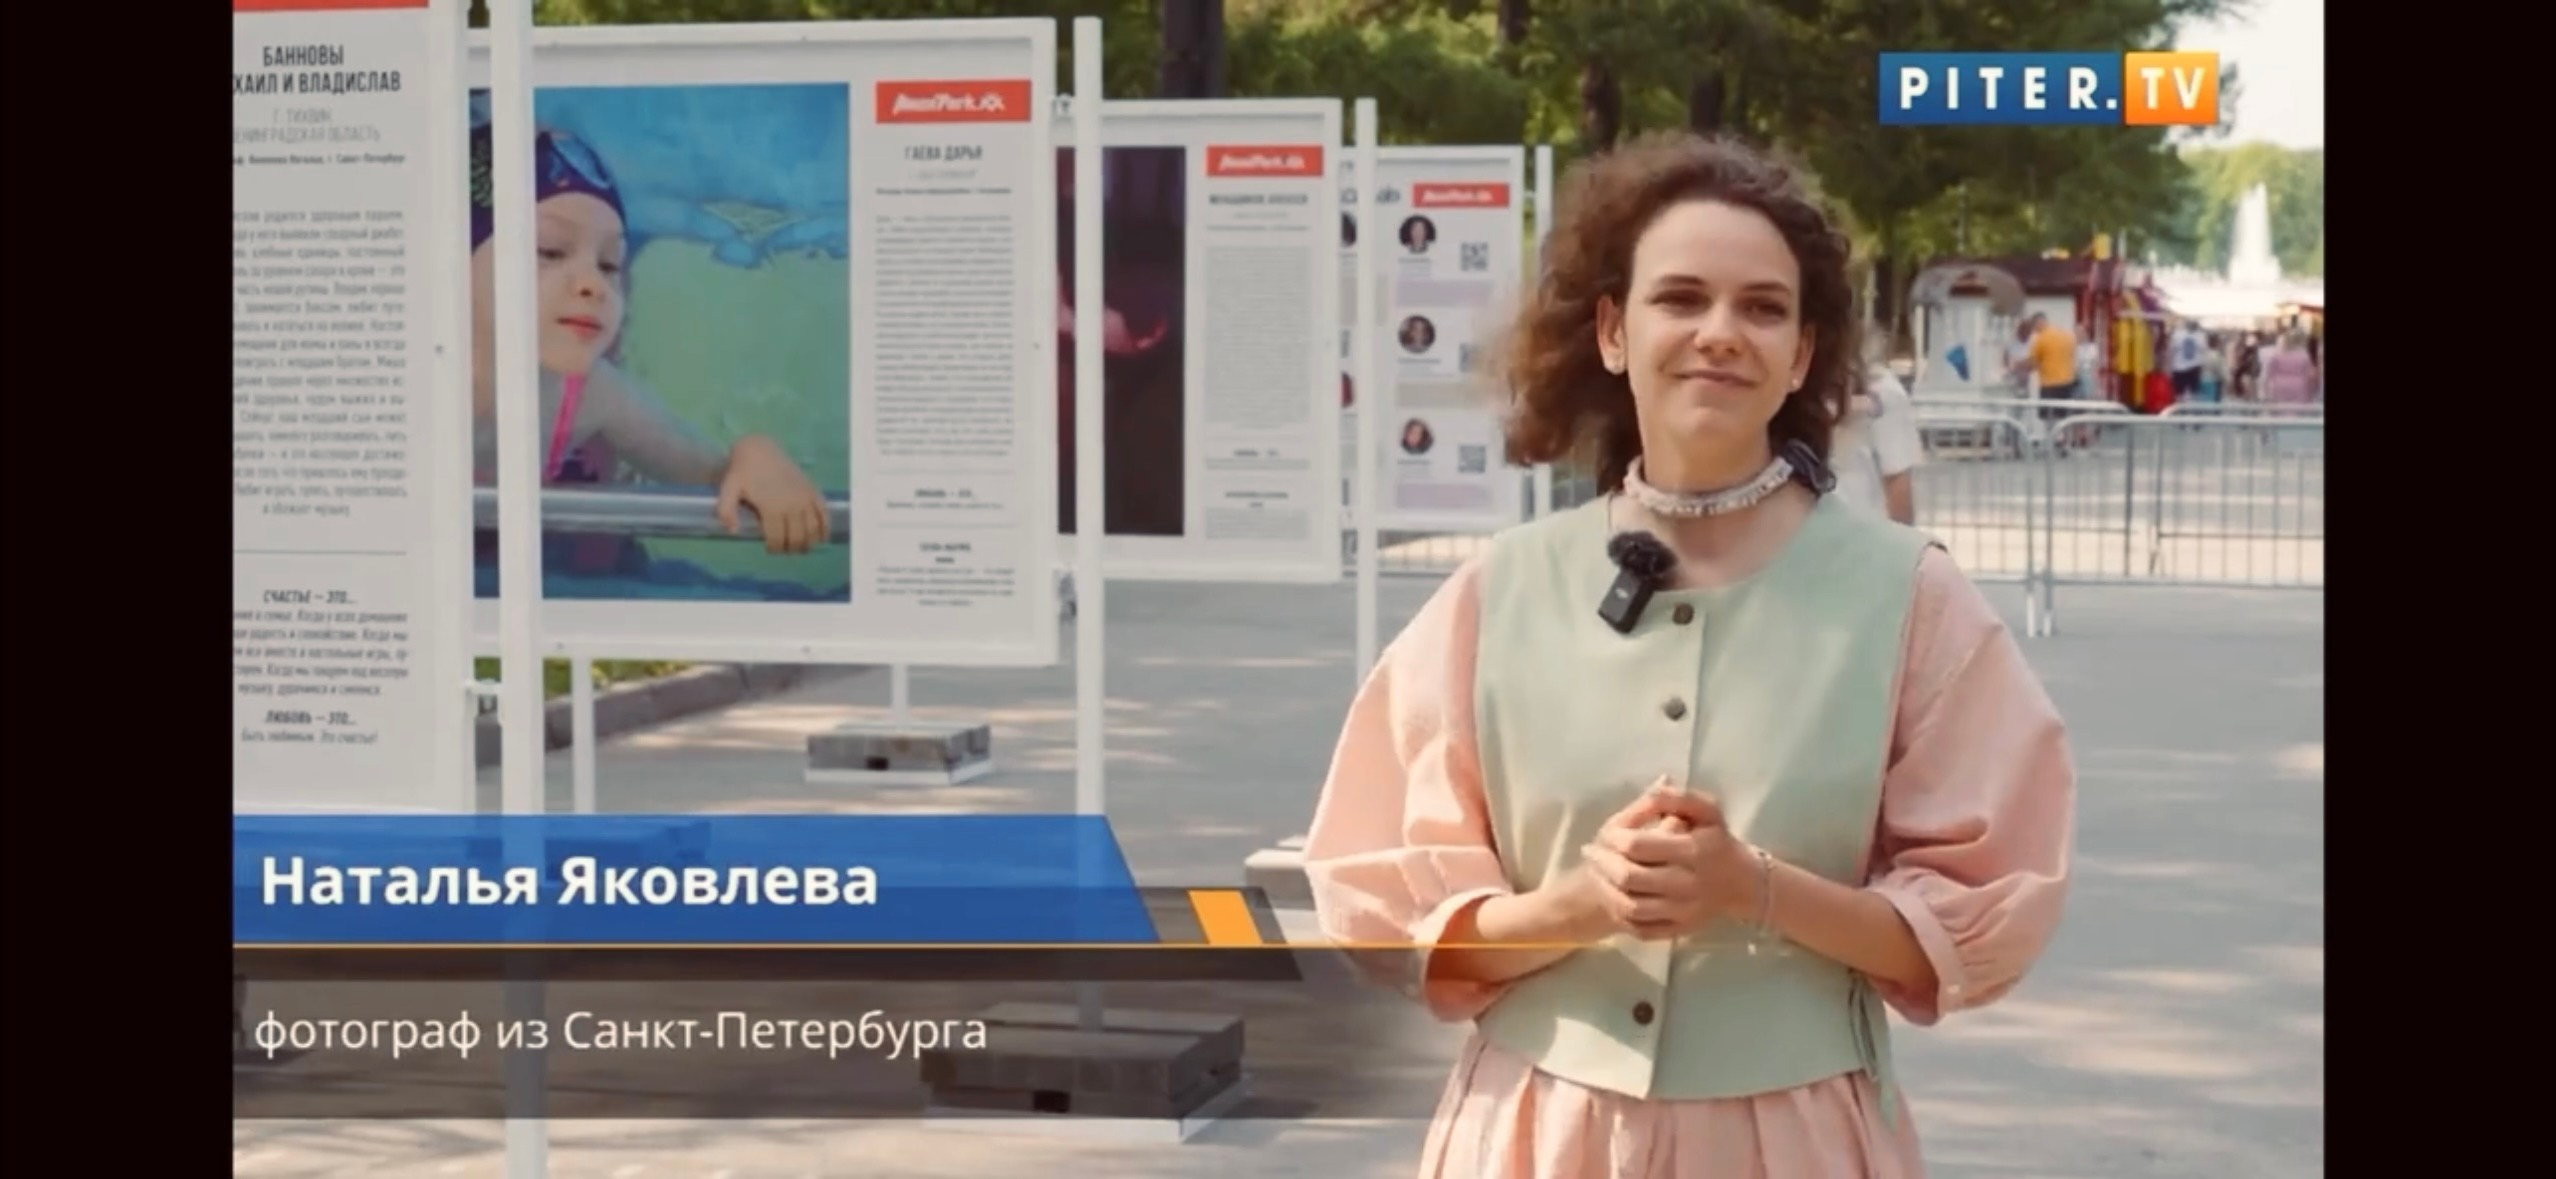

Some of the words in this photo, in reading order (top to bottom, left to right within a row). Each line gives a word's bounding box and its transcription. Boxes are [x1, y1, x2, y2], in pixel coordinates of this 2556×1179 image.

[263, 44, 344, 67] БАННОВЫ
[284, 73, 293, 92] И
[299, 70, 401, 94] ВЛАДИСЛАВ
[263, 590, 311, 603] СЧАСТЬЕ
[266, 709, 312, 724] ЛЮБОВЬ
